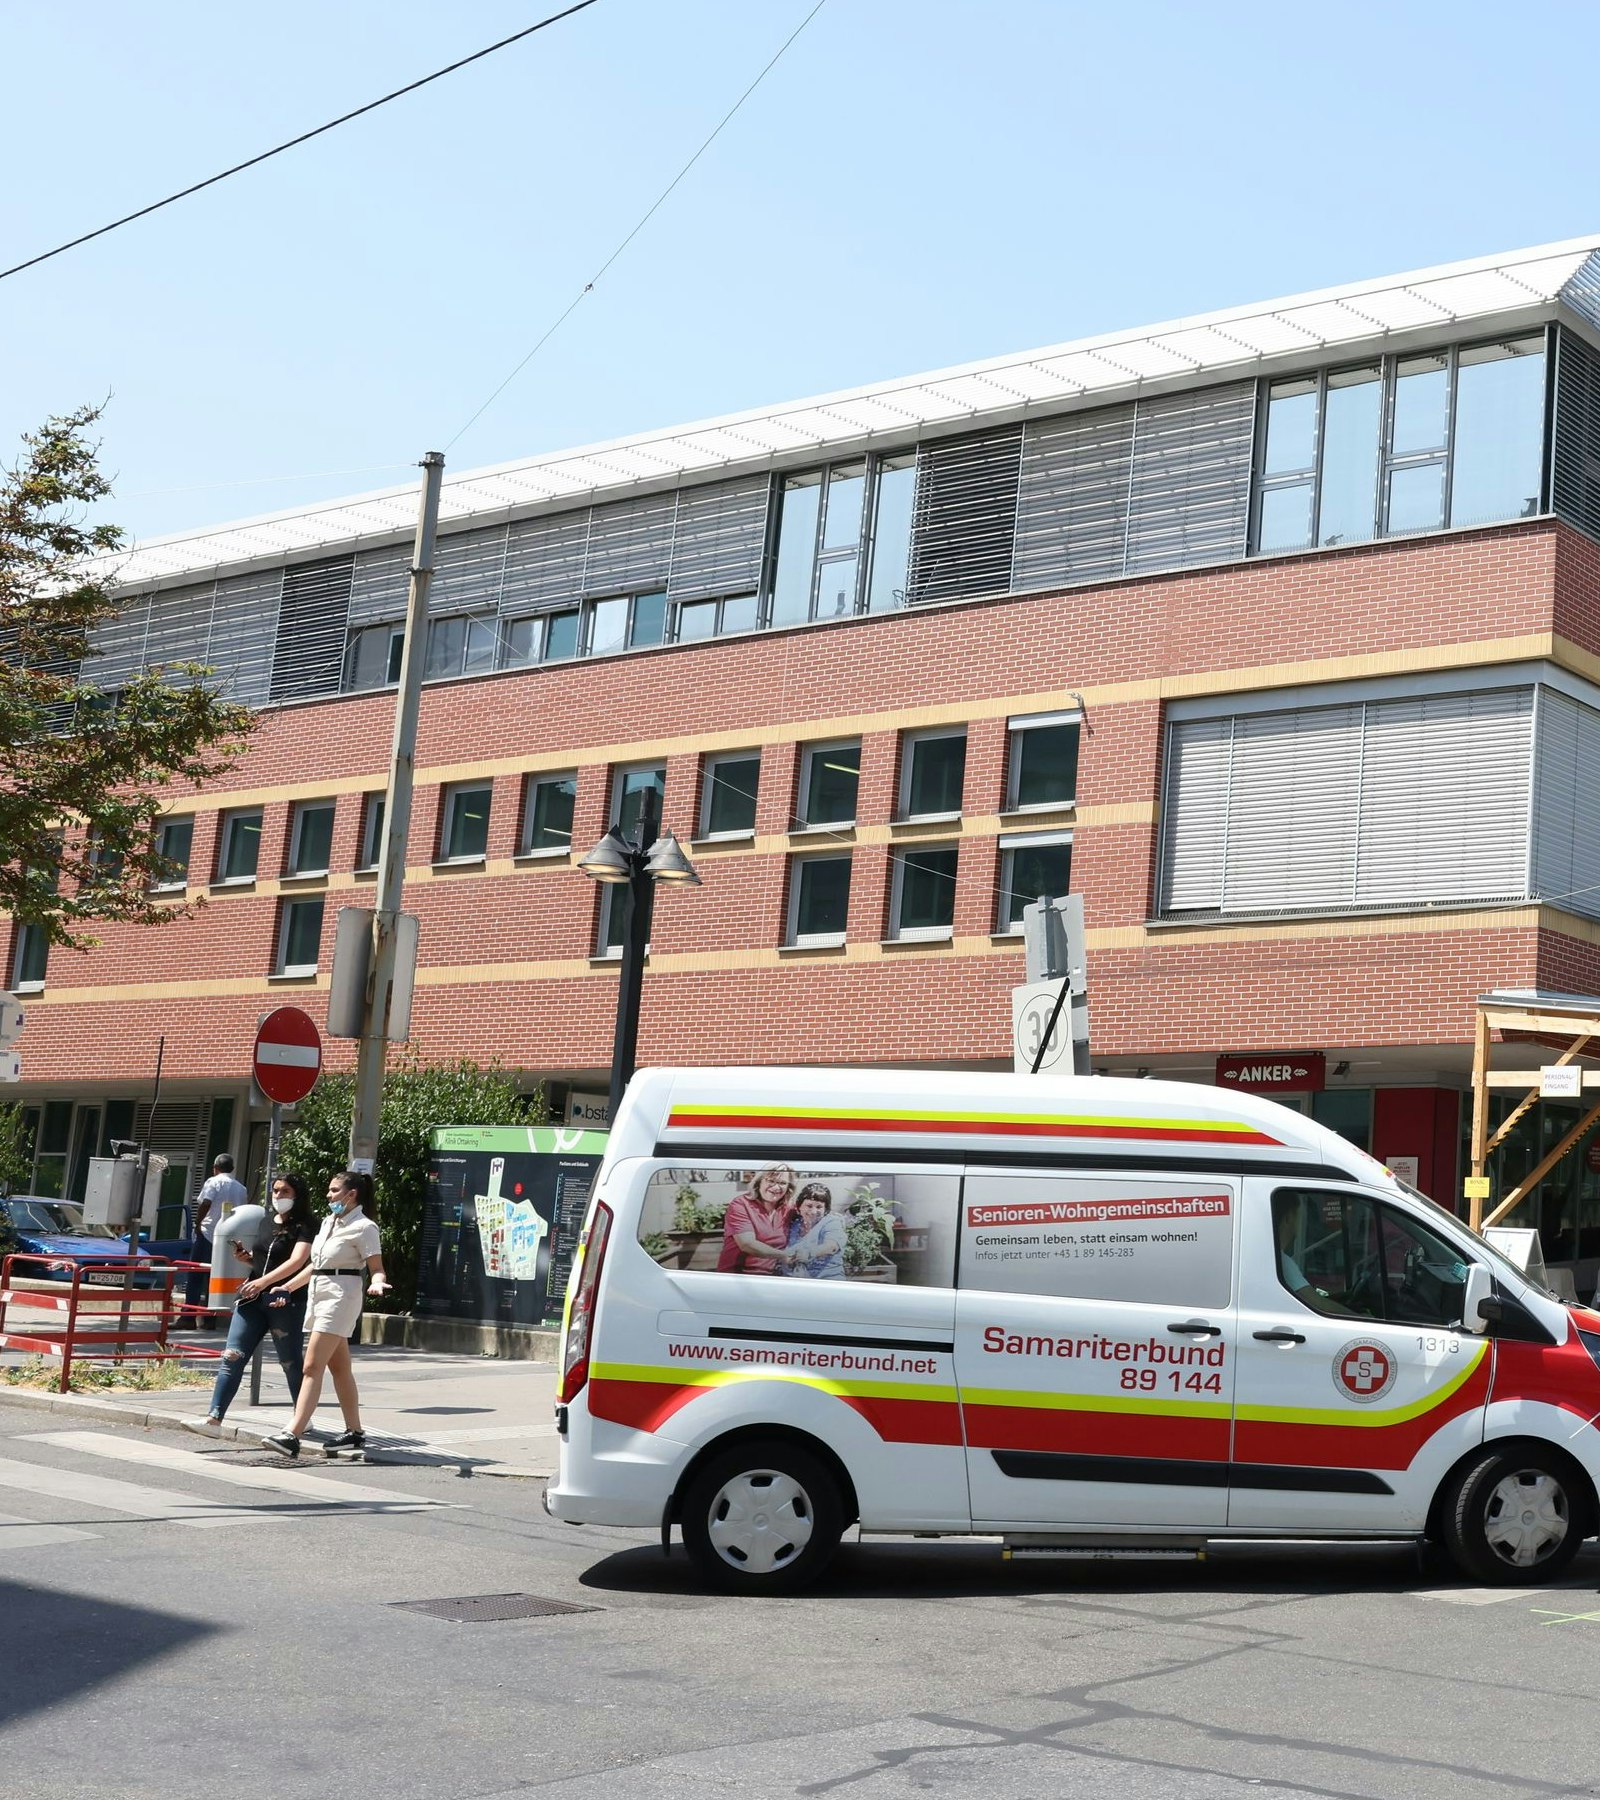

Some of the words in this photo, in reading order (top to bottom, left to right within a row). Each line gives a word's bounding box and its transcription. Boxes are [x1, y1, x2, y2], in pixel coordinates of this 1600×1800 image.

[1027, 1007, 1059, 1056] 30
[1238, 1064, 1292, 1083] ANKER
[457, 1137, 479, 1147] Ottakring
[972, 1198, 1225, 1224] Senioren-Wohngemeinschaften
[975, 1234, 1040, 1246] Gemeinsam
[1043, 1233, 1077, 1245] leben,
[1080, 1233, 1106, 1244] statt
[1109, 1233, 1148, 1243] einsam
[1151, 1232, 1198, 1242] wohnen!
[975, 1250, 998, 1261] Infos
[1000, 1250, 1022, 1262] jetzt
[1025, 1250, 1050, 1260] unter
[1053, 1249, 1071, 1259] +43
[1074, 1249, 1080, 1258] 1
[1083, 1248, 1095, 1258] 89
[1098, 1248, 1134, 1258] 145-283
[983, 1326, 1225, 1367] Samariterbund
[1416, 1336, 1460, 1354] 1313
[668, 1343, 937, 1374] www.samariterbund.net
[1358, 1361, 1371, 1378] S
[1120, 1368, 1156, 1391] 89
[1167, 1371, 1222, 1395] 144
